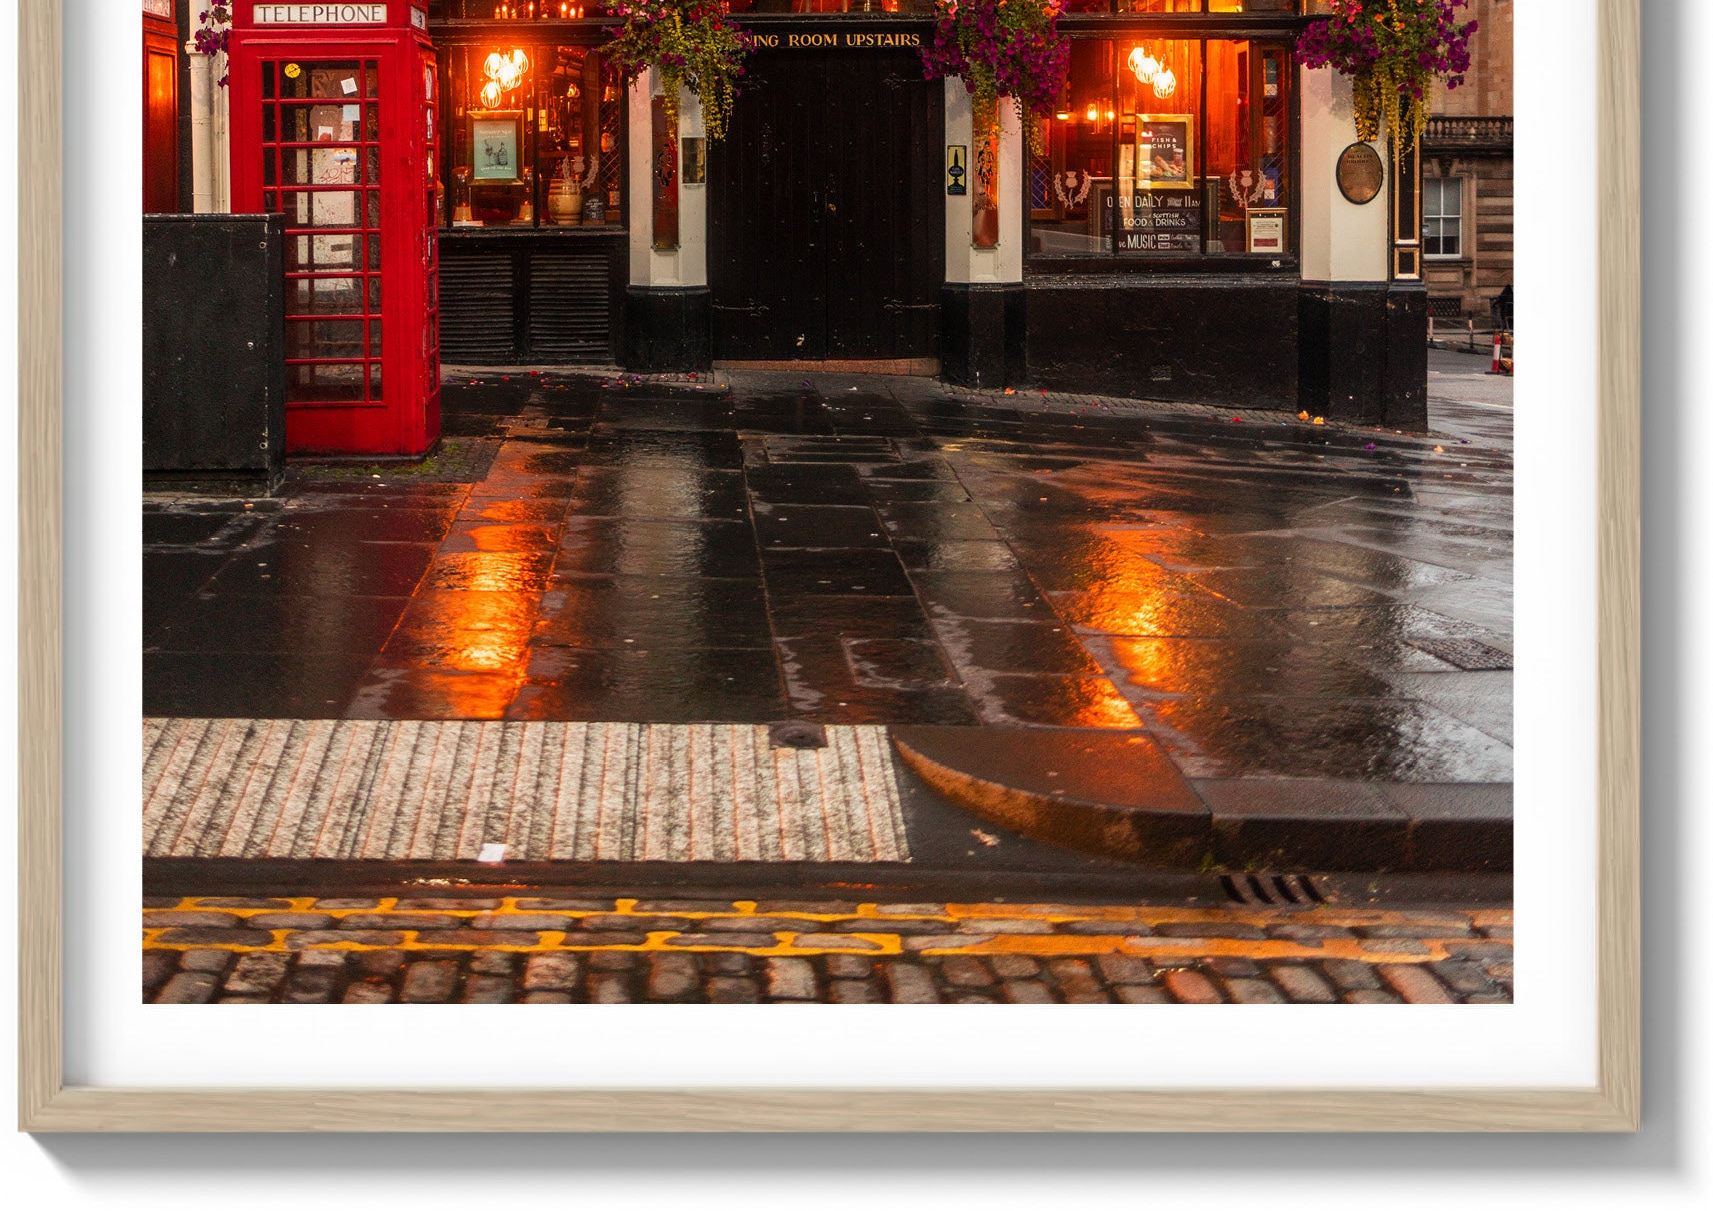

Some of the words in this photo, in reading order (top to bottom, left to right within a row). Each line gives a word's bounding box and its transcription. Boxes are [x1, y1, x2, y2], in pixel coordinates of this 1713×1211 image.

[258, 5, 381, 23] TELEPHONE
[788, 33, 837, 46] ROOM
[846, 33, 920, 46] UPSTAIRS
[1106, 196, 1132, 208] OEN
[1135, 195, 1164, 208] DAILY
[1123, 218, 1148, 227] FOOD
[1155, 218, 1186, 227] DRINKS
[1127, 234, 1157, 249] MUSIC
